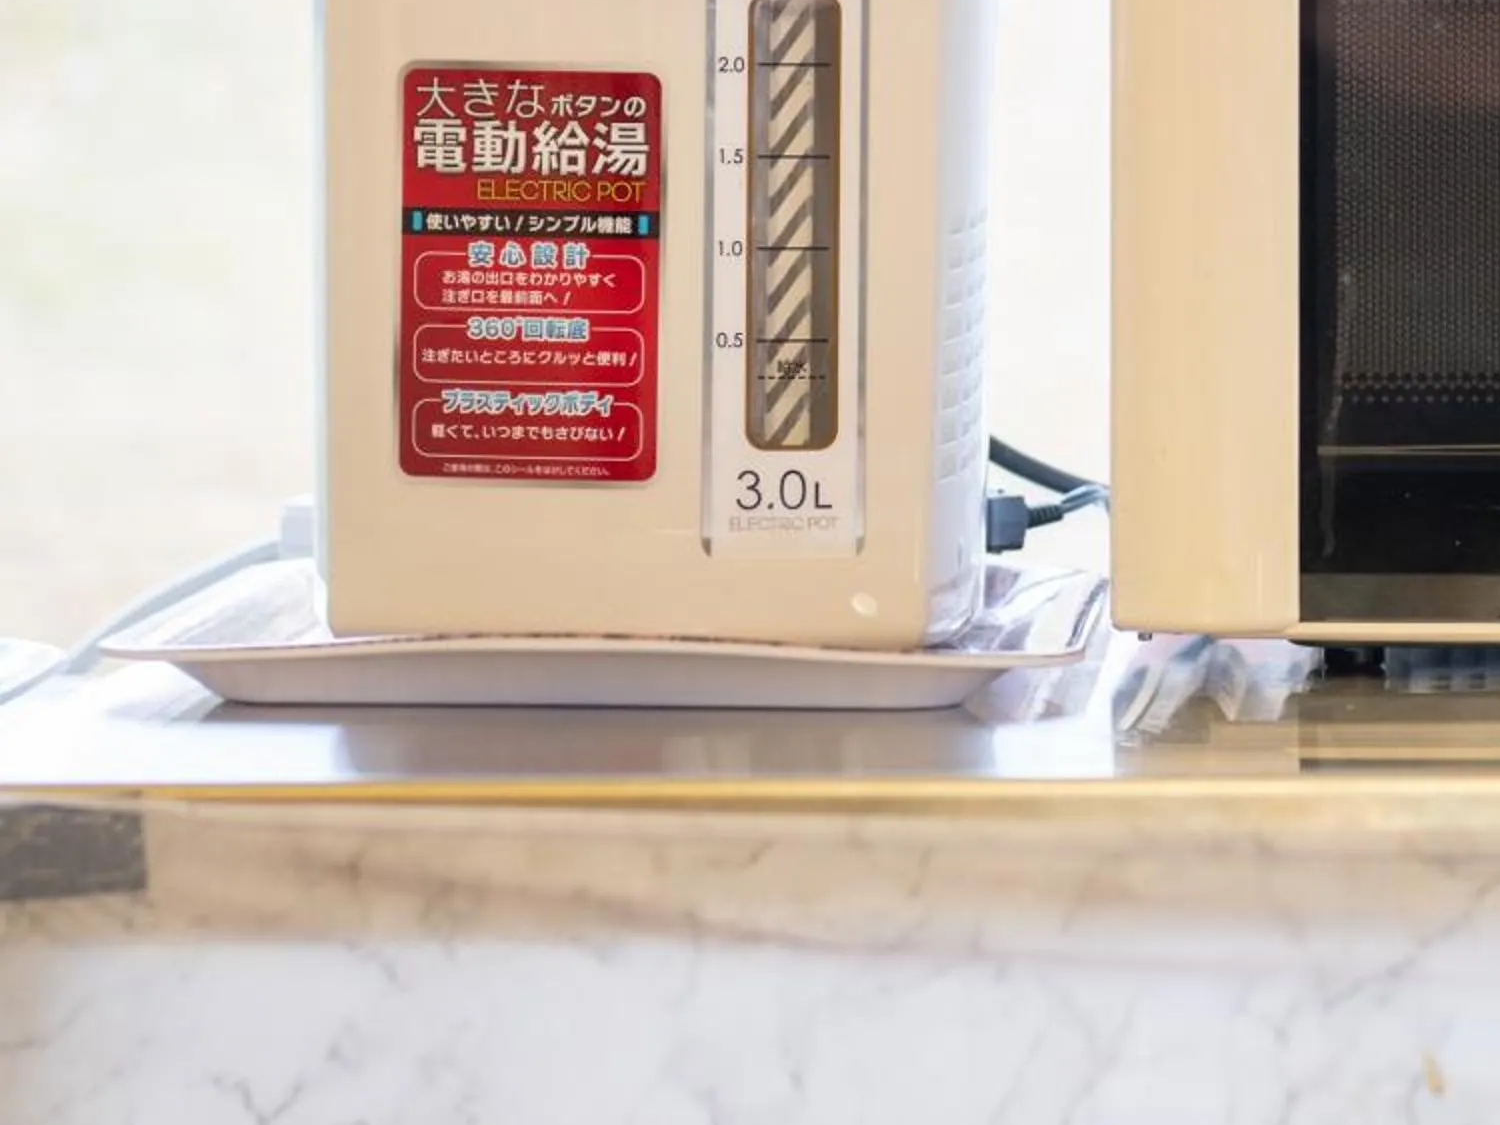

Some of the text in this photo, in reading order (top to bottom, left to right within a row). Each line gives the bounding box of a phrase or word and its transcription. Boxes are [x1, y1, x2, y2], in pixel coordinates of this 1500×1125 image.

[717, 56, 745, 74] 2.0
[413, 119, 649, 176] 電動給湯
[718, 148, 744, 165] 1.5
[476, 179, 646, 203] ELECTRIC POT
[468, 241, 590, 269] 安心設計
[718, 240, 743, 257] 1.0
[716, 332, 743, 348] 0.5
[442, 390, 615, 417] プラスティックボディ
[736, 470, 833, 510] 3.0L
[728, 516, 840, 532] ELECTRIC POT
